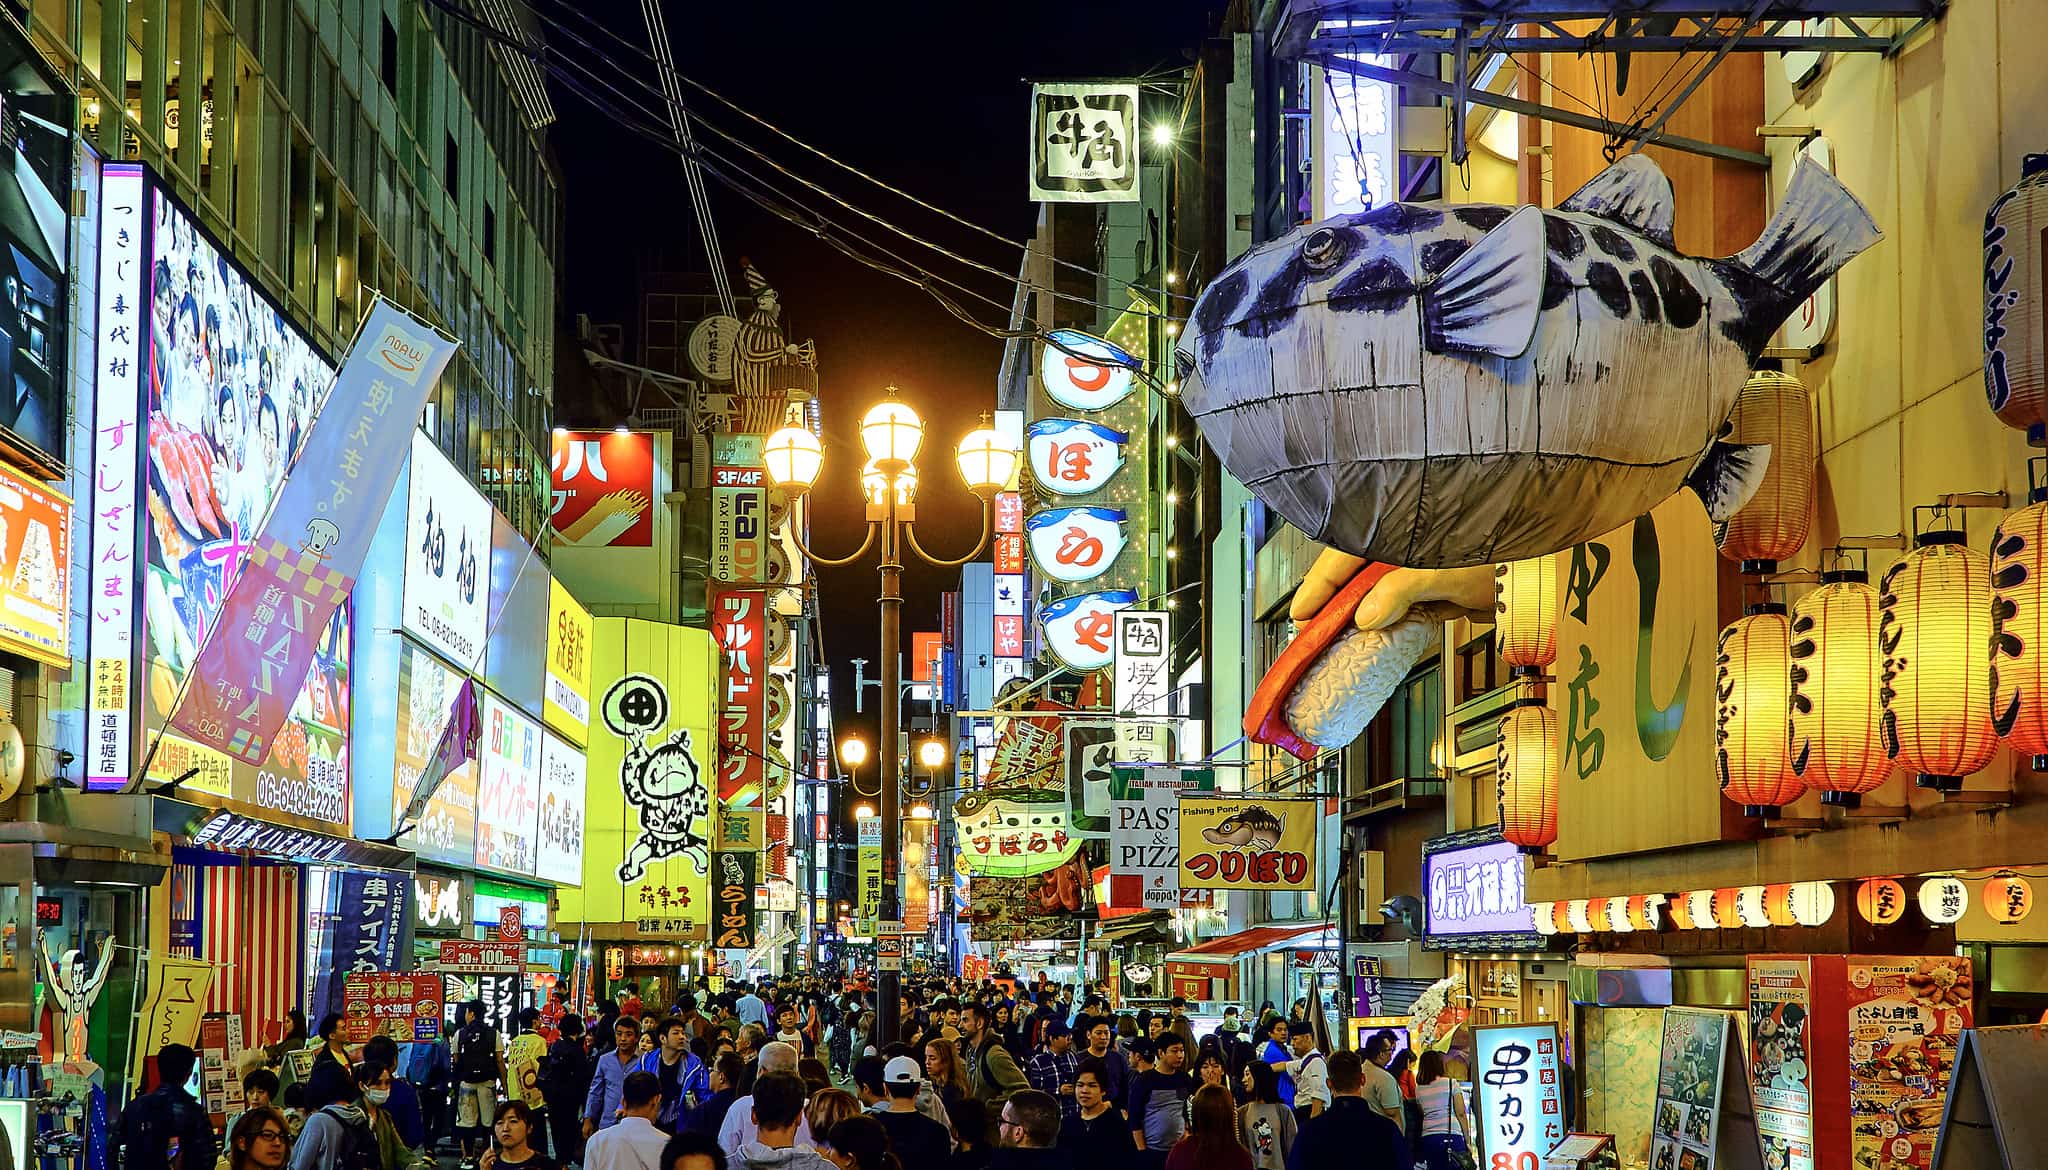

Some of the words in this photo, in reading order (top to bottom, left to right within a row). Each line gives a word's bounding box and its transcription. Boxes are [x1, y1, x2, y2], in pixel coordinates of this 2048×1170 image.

[1048, 111, 1123, 169] 牛角
[109, 205, 133, 378] つきじ喜代村
[717, 471, 762, 485] 3F/4F
[98, 419, 134, 623] すしざんまい
[719, 495, 729, 517] TAX
[719, 521, 729, 550] FREE
[719, 556, 729, 583] SHO
[1128, 624, 1159, 649] 牛角
[97, 661, 109, 709] 年中無休
[111, 660, 123, 709] 24時間
[723, 598, 752, 780] ツルハドラッグ
[1127, 661, 1158, 763] 焼肉酒家
[100, 714, 117, 773] 道頓堀店
[256, 771, 345, 825] 06-6484-2280
[1128, 780, 1153, 789] ITALIAN
[1157, 780, 1199, 789] RESTAURANT
[1182, 807, 1215, 817] Fishing
[1216, 805, 1239, 815] Pond
[1152, 831, 1169, 845] &
[664, 918, 692, 932] 47年
[717, 884, 750, 949] らーめん
[1857, 1006, 1919, 1019] たよし自慢
[1484, 1041, 1532, 1146] 串カツ
[1536, 1039, 1557, 1114] 新鮮居酒屋
